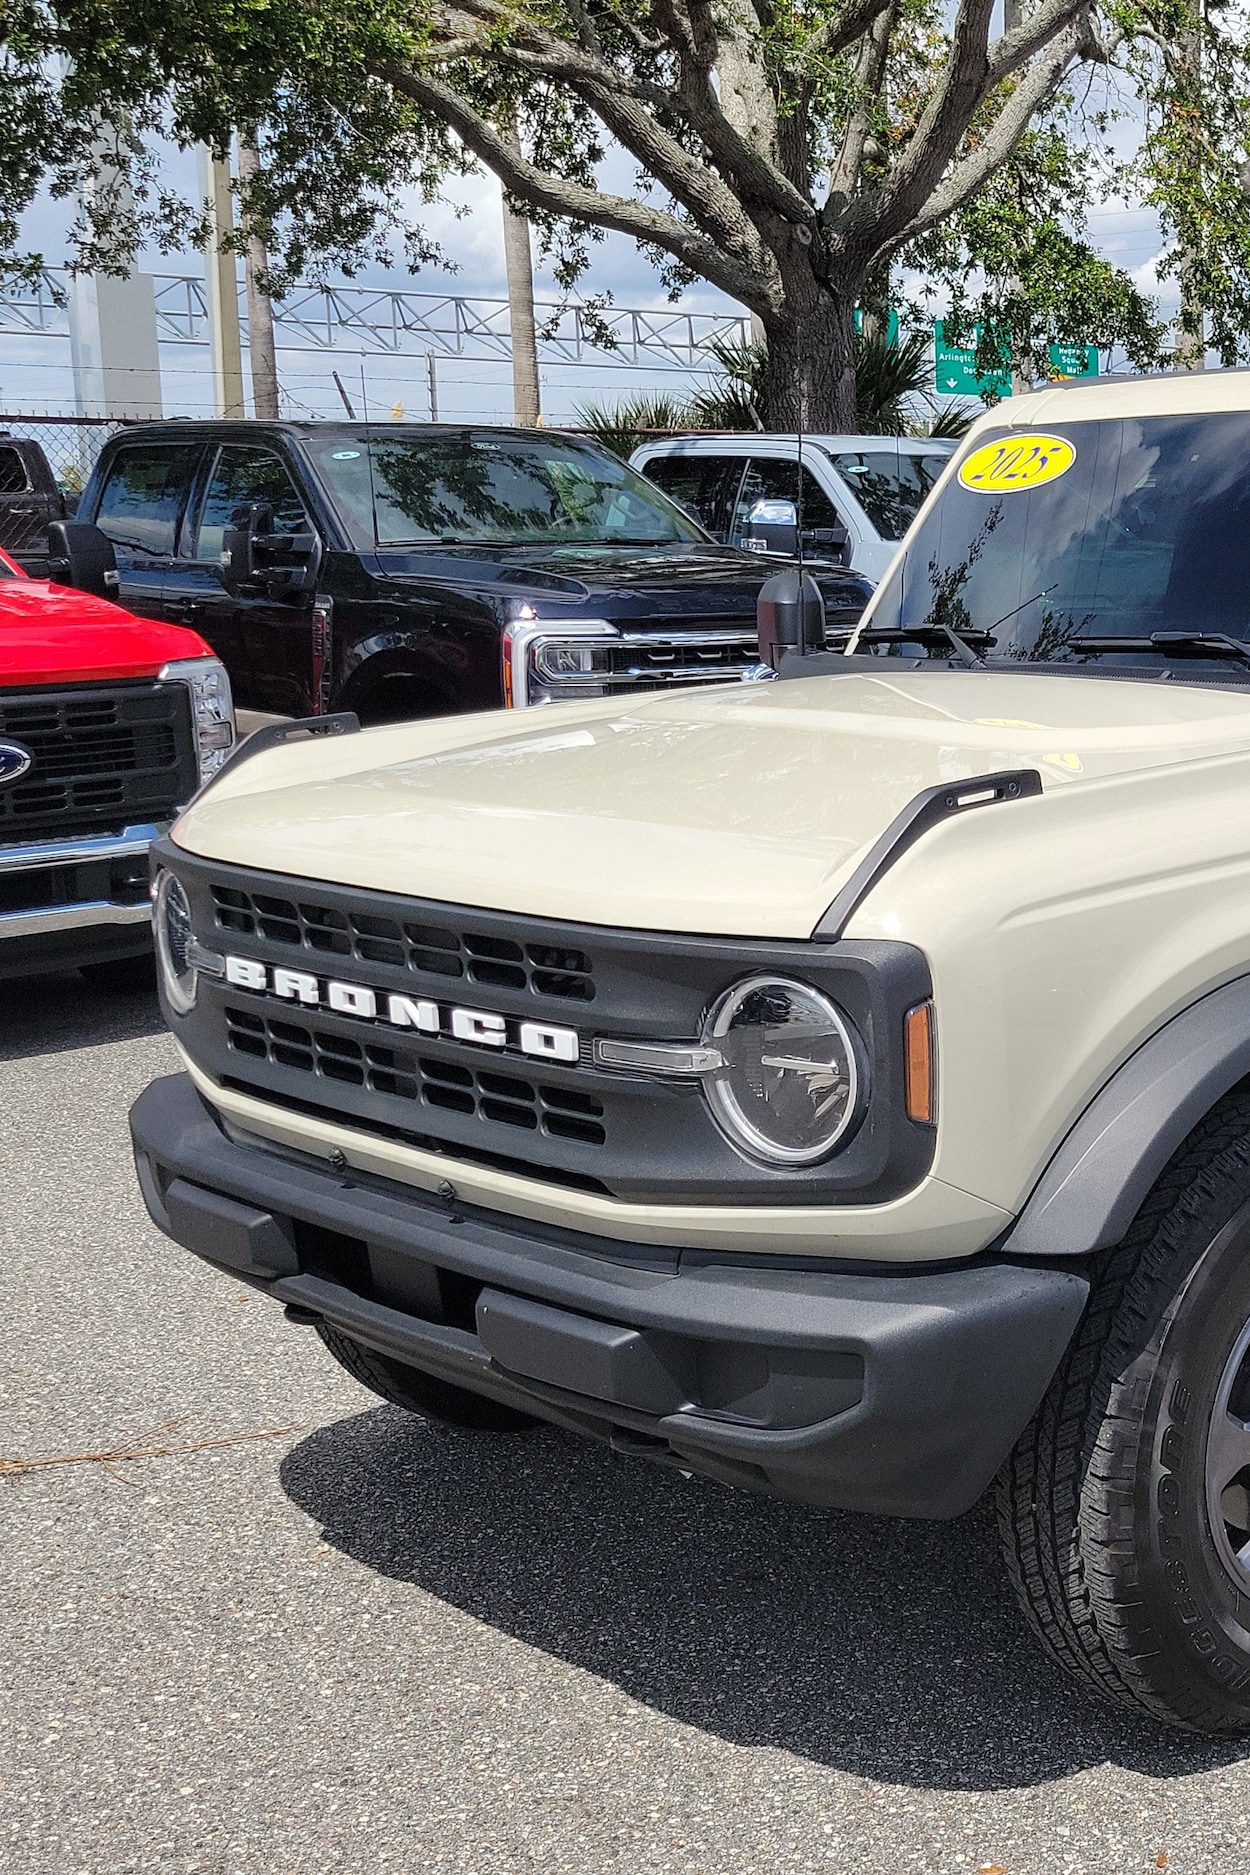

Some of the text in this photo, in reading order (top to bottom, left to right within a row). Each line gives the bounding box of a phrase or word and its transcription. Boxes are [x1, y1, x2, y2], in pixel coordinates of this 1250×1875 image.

[939, 353, 976, 364] Arlingto
[1061, 355, 1088, 365] Squae
[963, 366, 1003, 377] Dowtown
[970, 446, 1062, 481] 2025
[225, 956, 580, 1062] BRONCO
